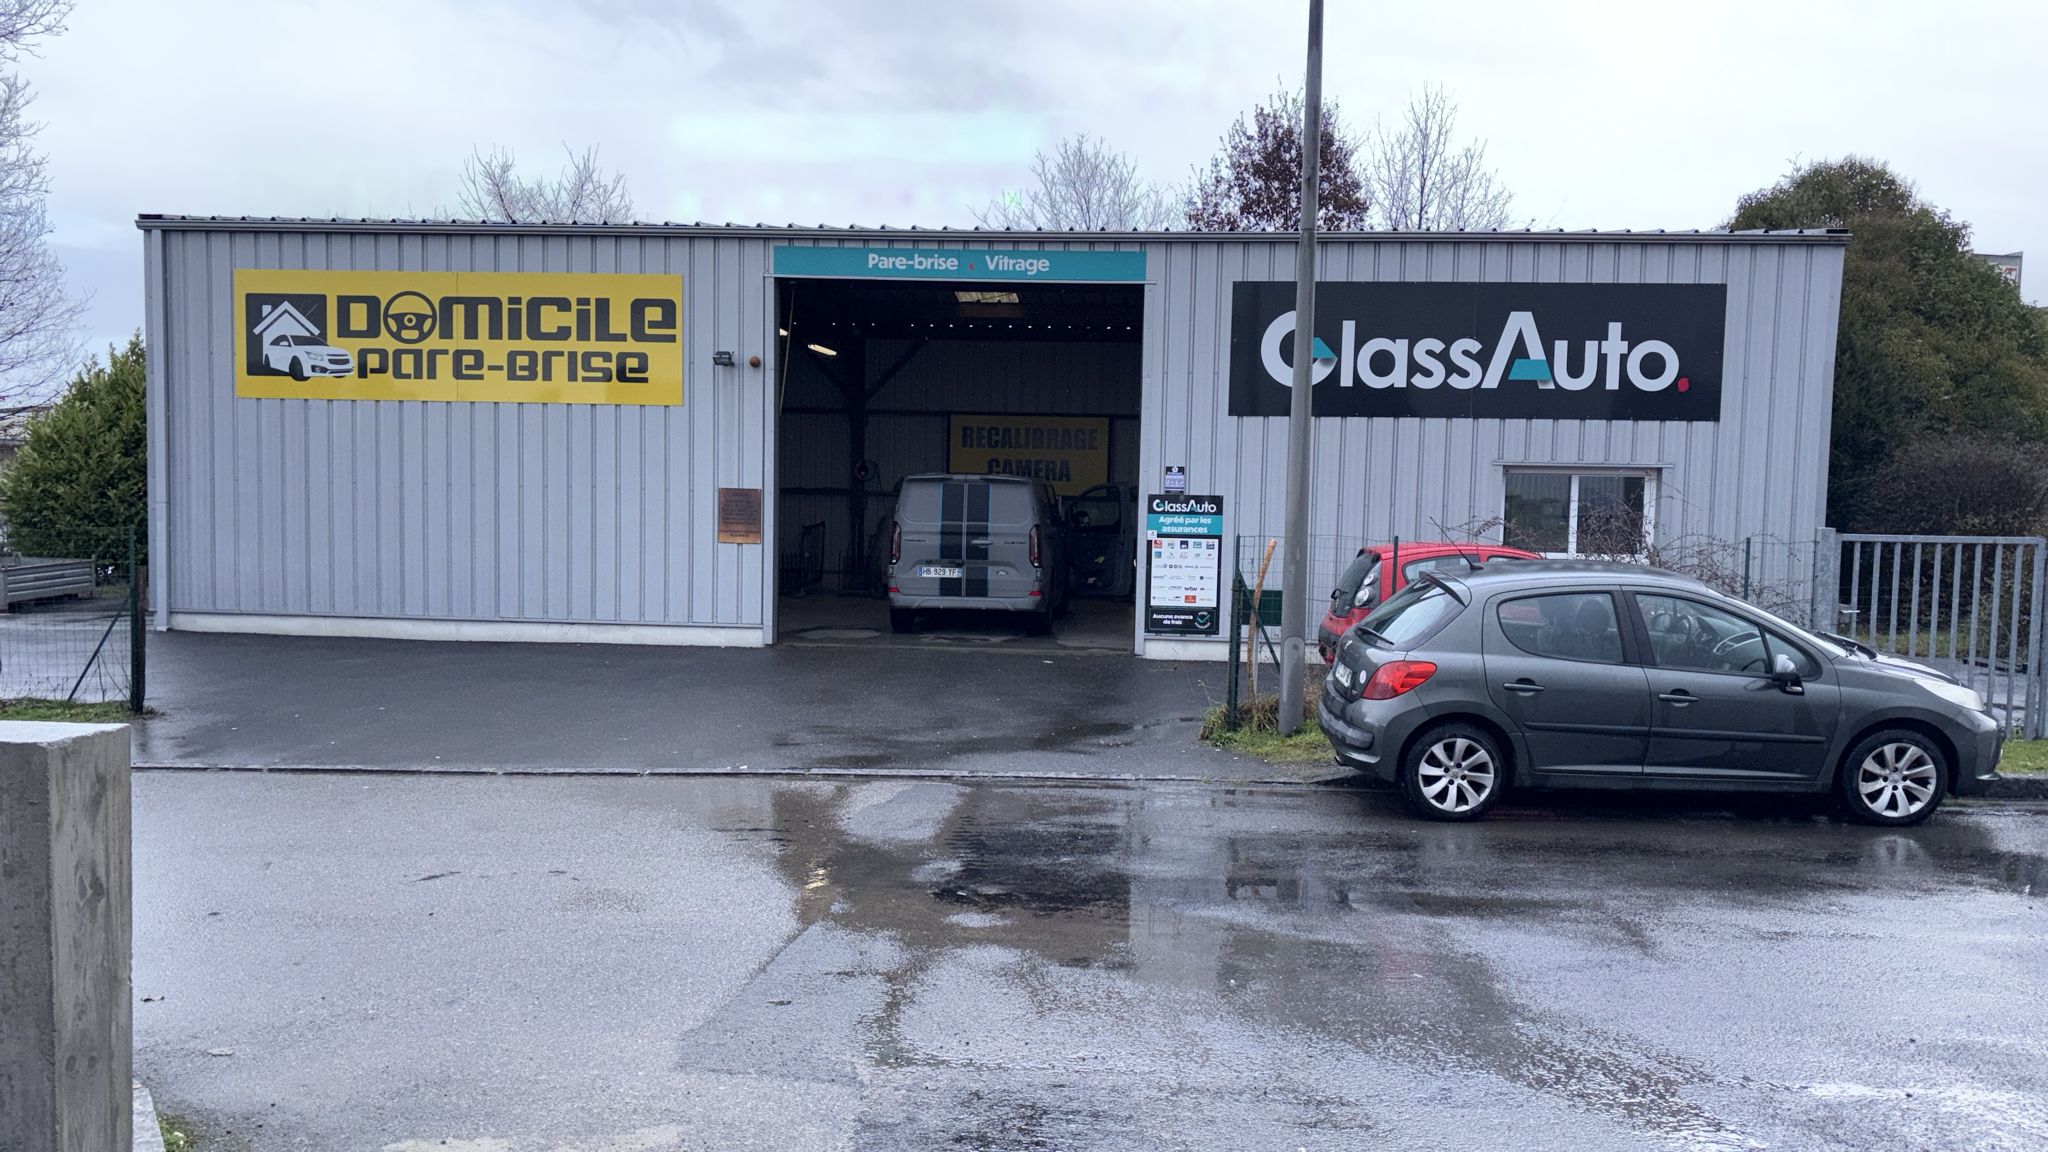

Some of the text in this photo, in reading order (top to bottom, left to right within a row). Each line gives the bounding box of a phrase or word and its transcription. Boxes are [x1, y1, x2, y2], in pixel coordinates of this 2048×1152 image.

[868, 253, 1050, 275] Pare-brise Vitrage
[962, 425, 1098, 450] RECALIBRAGE
[987, 458, 1072, 482] CAMERA
[1159, 516, 1185, 525] Agréé
[1200, 516, 1212, 524] les
